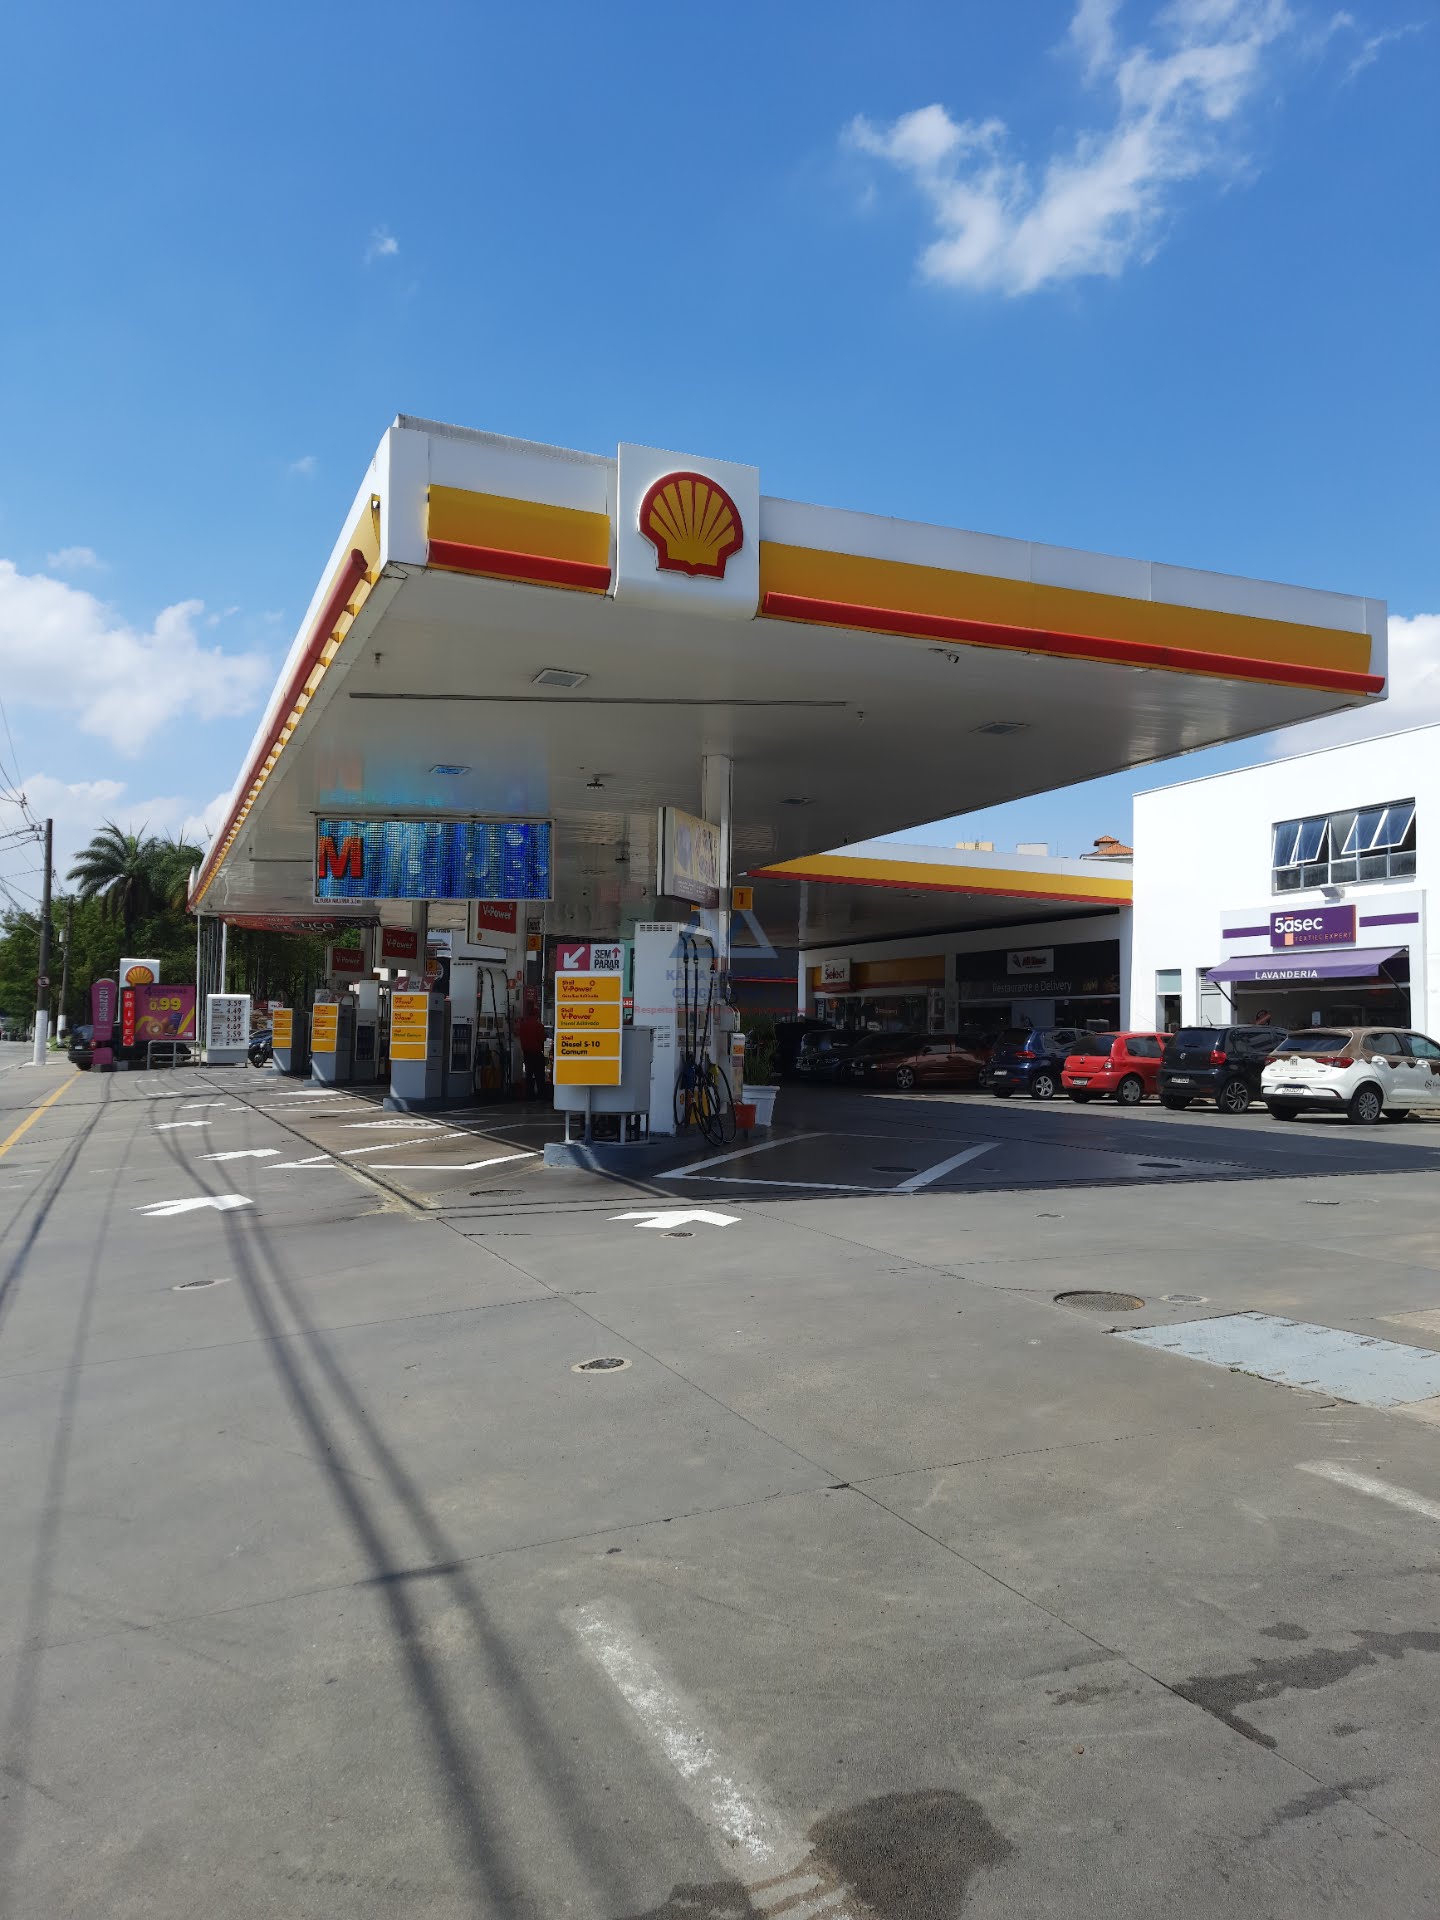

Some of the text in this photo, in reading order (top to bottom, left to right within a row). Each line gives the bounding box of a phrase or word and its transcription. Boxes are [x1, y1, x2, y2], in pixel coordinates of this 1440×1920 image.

[482, 905, 512, 920] V-Power
[386, 938, 413, 949] V-Power
[594, 949, 611, 959] SEM
[594, 959, 620, 969] PARAR
[825, 967, 845, 980] Select
[1255, 969, 1318, 980] LAVANDERIA
[992, 981, 1033, 993] Restaurante
[1040, 979, 1072, 993] Delivery
[561, 1040, 582, 1048] Diesel
